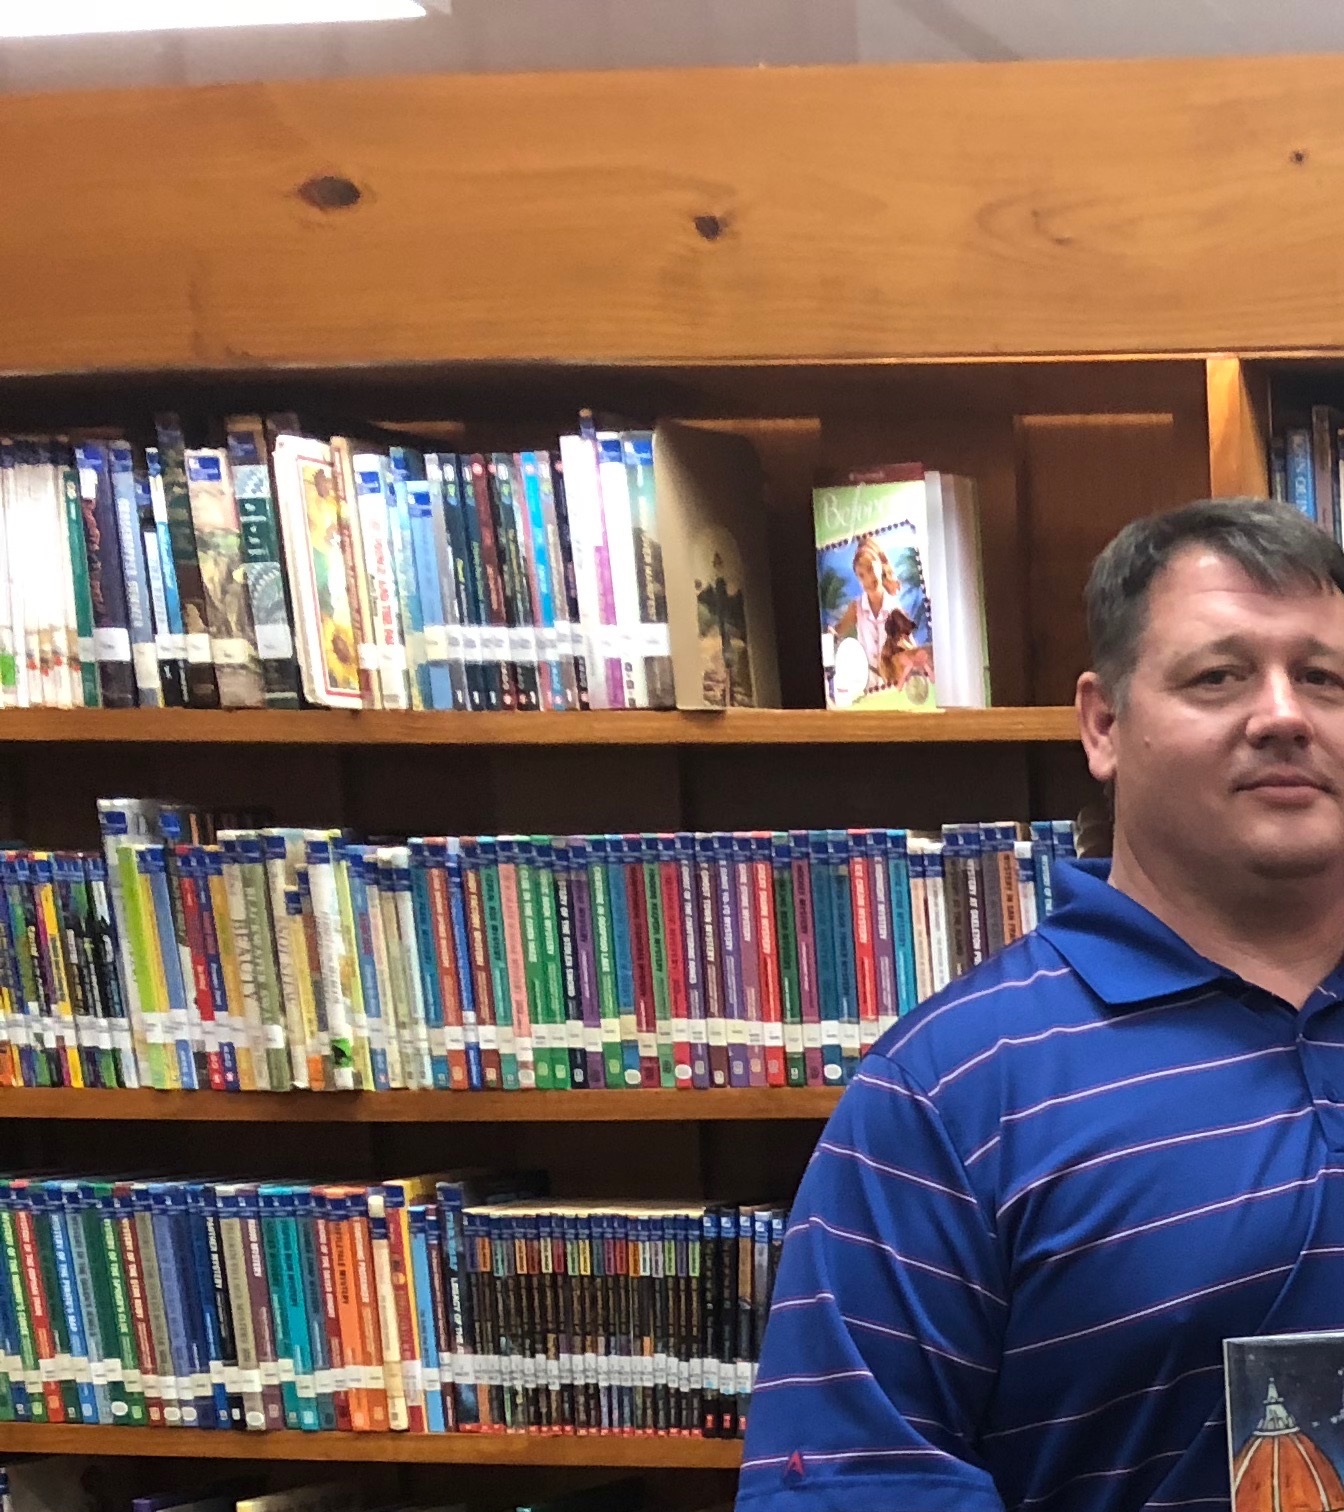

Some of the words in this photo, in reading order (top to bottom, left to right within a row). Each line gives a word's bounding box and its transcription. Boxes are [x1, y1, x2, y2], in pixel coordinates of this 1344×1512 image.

[561, 921, 570, 934] THE
[705, 924, 715, 961] MYSTERY
[51, 1215, 64, 1249] MYSTERY
[206, 1217, 218, 1252] PANTHER
[57, 1252, 66, 1261] OF
[250, 1244, 261, 1277] MYSTERY
[59, 1264, 68, 1277] THE
[110, 1263, 120, 1277] THE
[211, 1254, 222, 1289] MYSTERY
[67, 1315, 77, 1332] MAP
